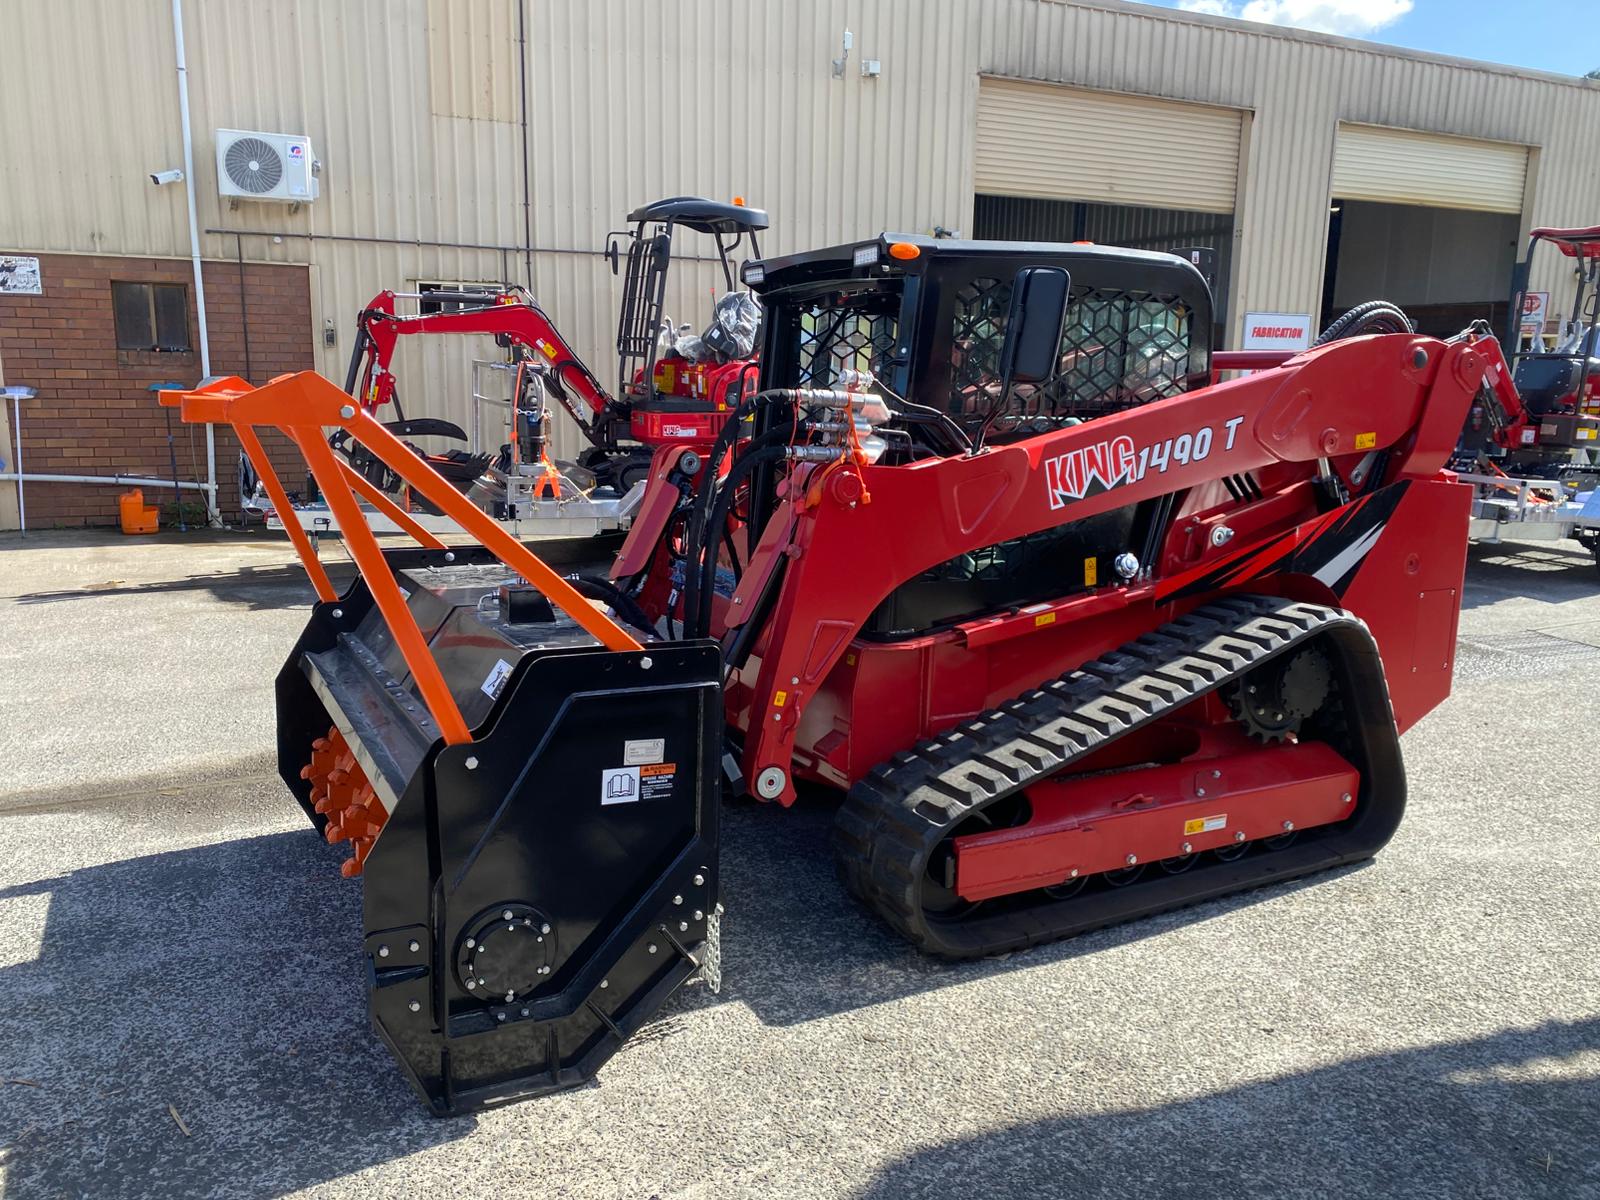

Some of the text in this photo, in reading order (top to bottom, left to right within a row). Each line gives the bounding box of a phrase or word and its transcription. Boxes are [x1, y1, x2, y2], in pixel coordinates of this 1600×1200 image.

[1252, 327, 1303, 338] FABRICATION
[1045, 416, 1244, 510] KING 1490 T
